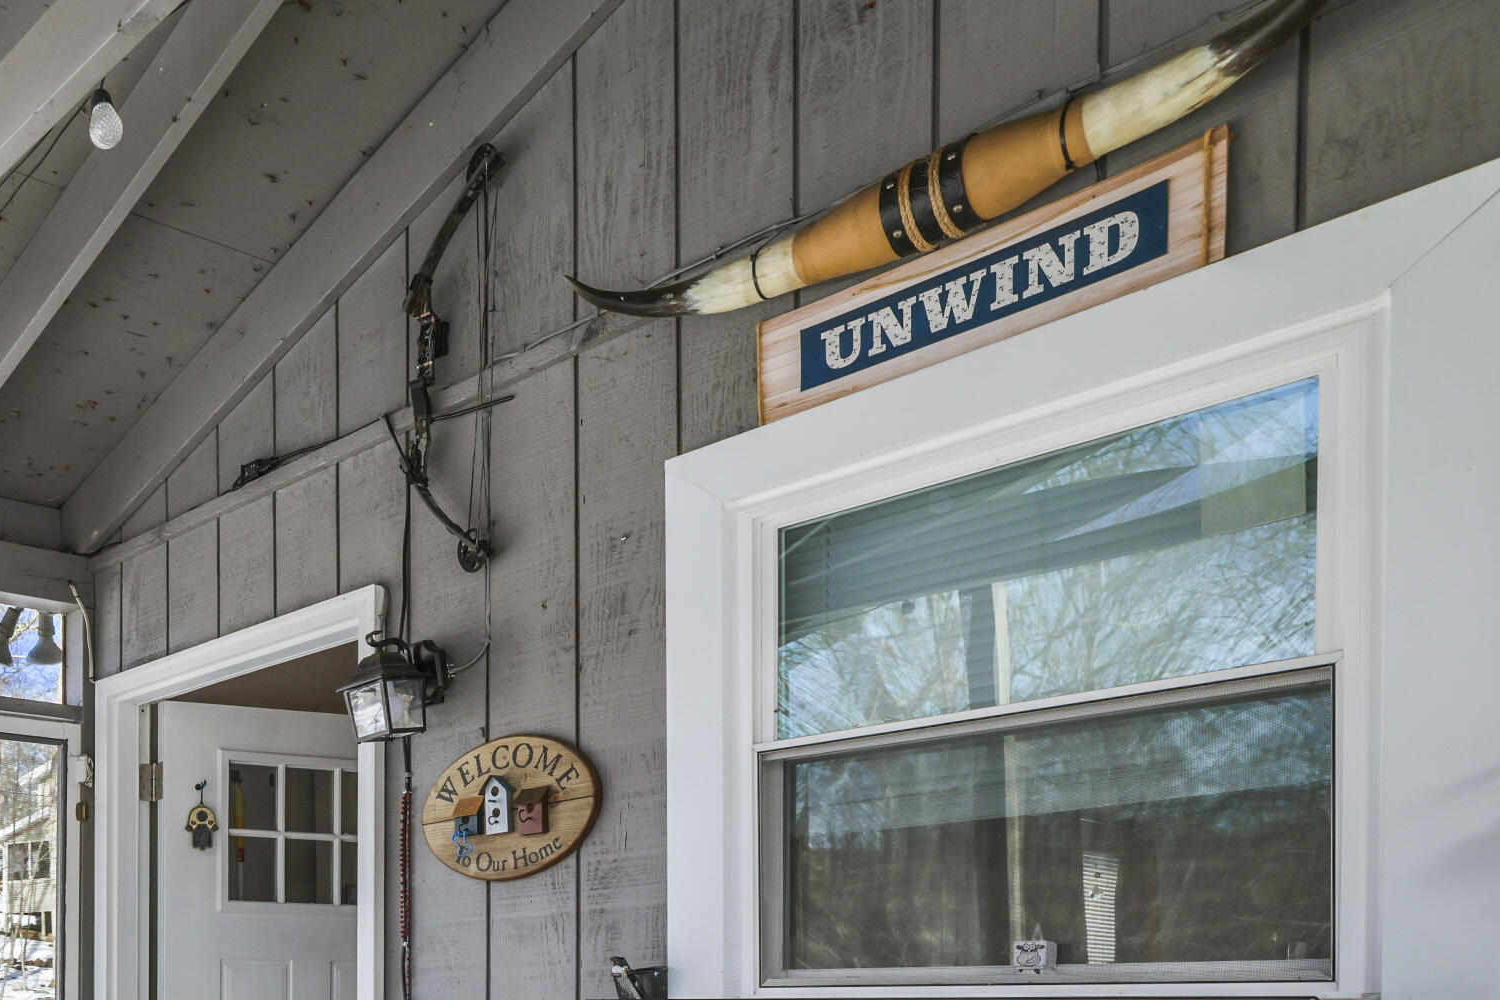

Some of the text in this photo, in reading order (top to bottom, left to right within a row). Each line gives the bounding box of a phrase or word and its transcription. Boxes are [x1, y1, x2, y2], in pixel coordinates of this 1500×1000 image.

[820, 210, 1140, 370] UNWIND
[435, 742, 580, 804] WELCOME
[476, 851, 507, 872] Our
[511, 837, 563, 870] Home
